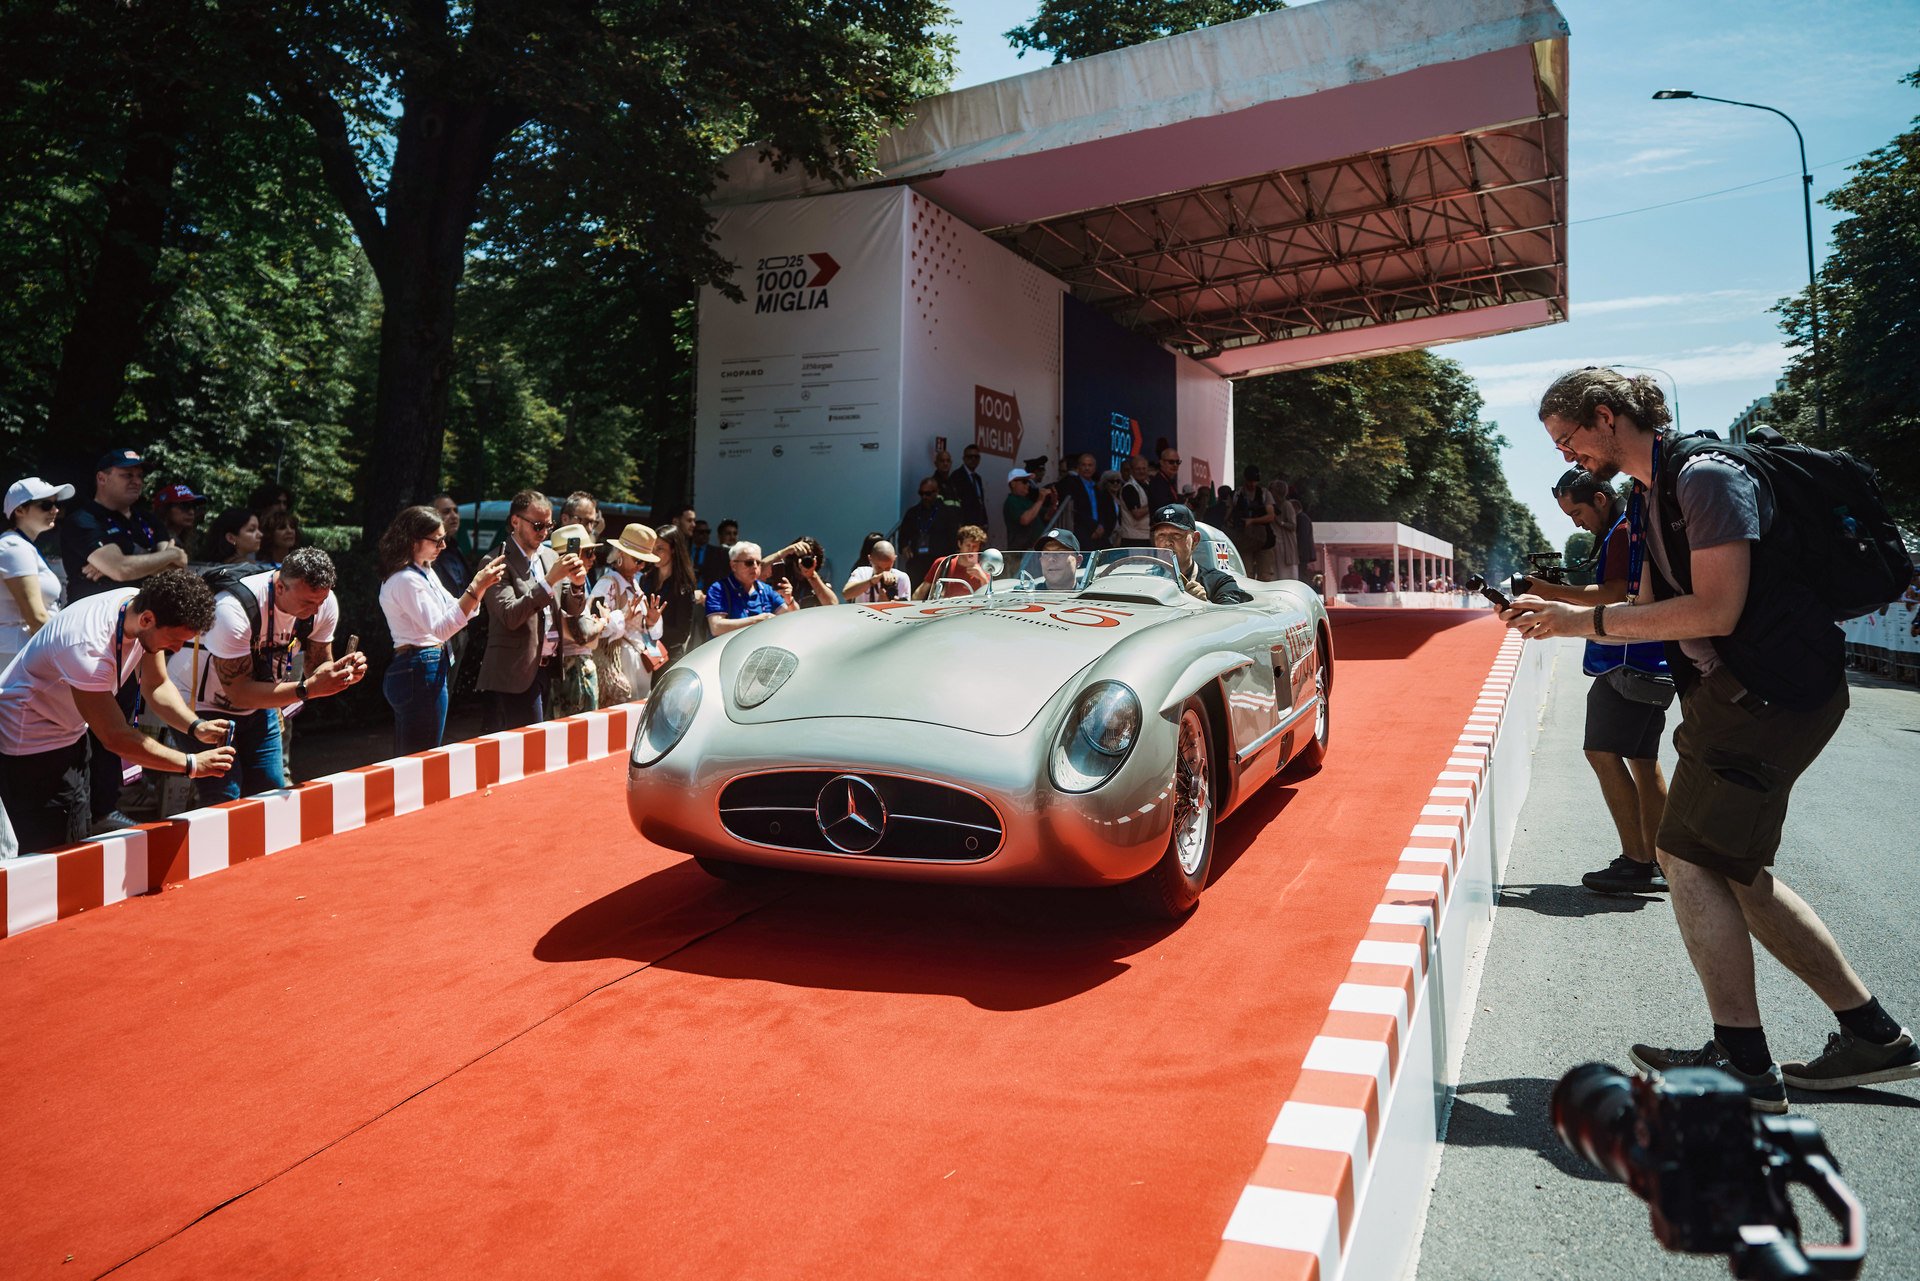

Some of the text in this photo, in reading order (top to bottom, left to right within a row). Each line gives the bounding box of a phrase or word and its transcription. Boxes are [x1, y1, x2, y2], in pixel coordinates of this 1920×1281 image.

[757, 254, 804, 271] 2025
[756, 268, 807, 292] 1000
[754, 288, 829, 314] MIGLIA
[720, 368, 764, 379] CHOPARD
[980, 393, 1012, 423] 1000
[977, 425, 1014, 454] MIGLIA
[1111, 429, 1131, 456] 1000
